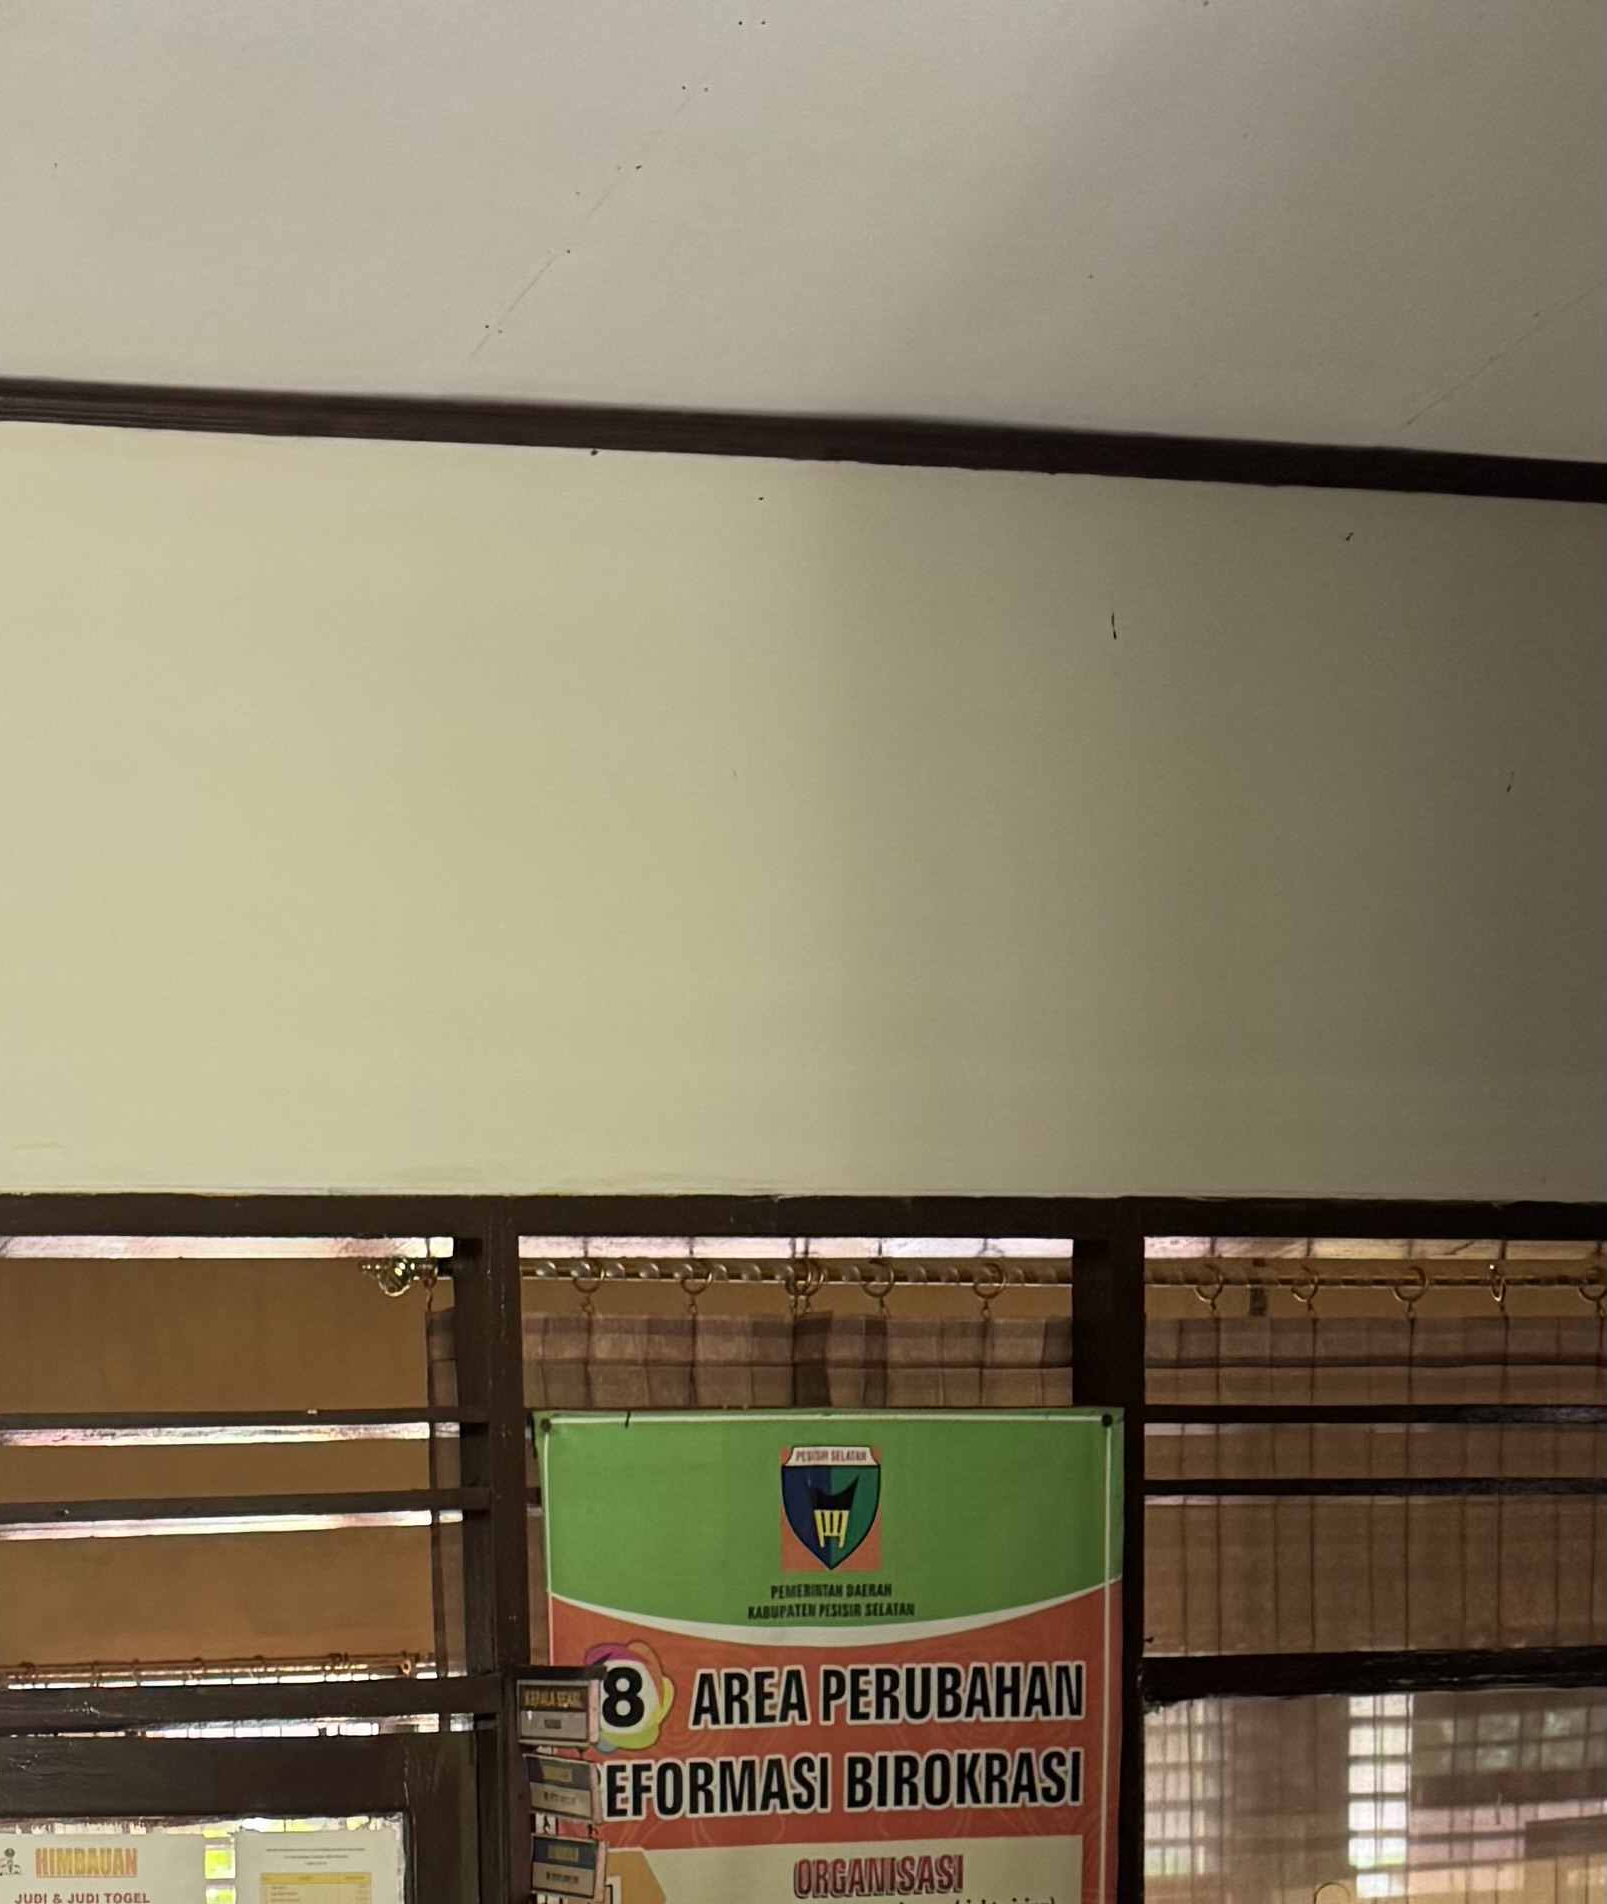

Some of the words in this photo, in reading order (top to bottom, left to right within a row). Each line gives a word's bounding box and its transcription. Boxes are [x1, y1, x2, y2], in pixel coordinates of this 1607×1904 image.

[602, 1665, 645, 1728] 8
[693, 1668, 808, 1728] AREA
[822, 1663, 1084, 1722] PERUBAHAN
[600, 1757, 830, 1820] EFORMASI
[847, 1750, 1083, 1809] BIROKRASI
[35, 1848, 138, 1876] HIMBAUAN
[794, 1854, 964, 1898] ORGANISASI
[15, 1893, 47, 1904] JUDI
[52, 1893, 62, 1904] &
[67, 1893, 99, 1904] JUDI
[103, 1893, 151, 1904] TOGEL
